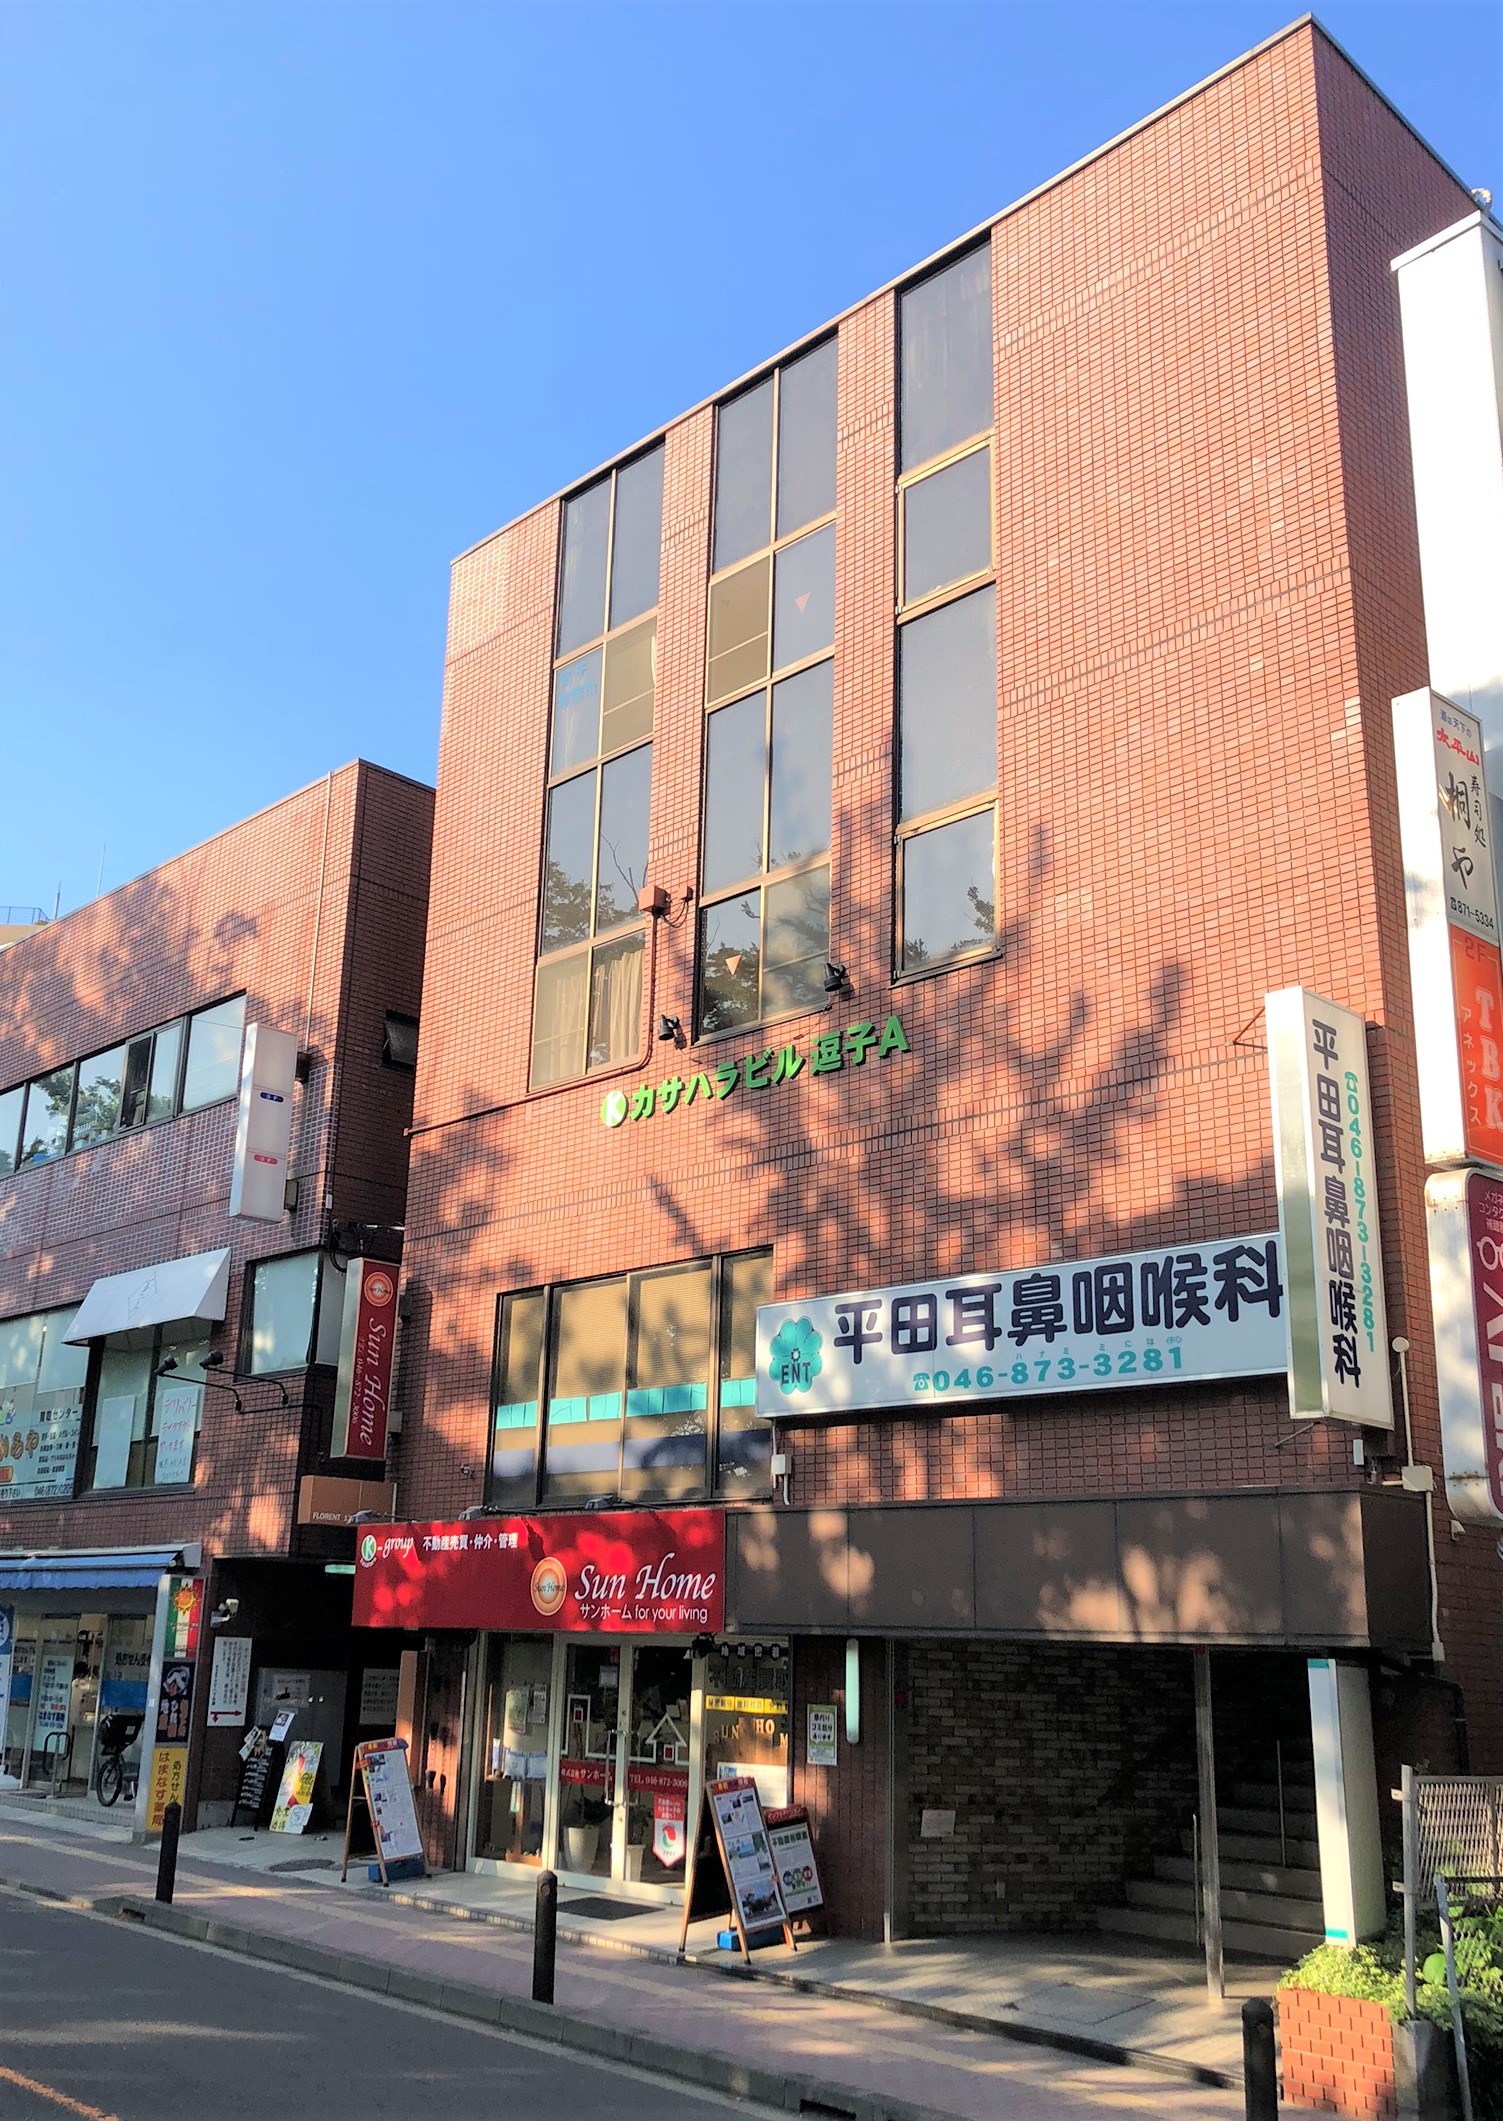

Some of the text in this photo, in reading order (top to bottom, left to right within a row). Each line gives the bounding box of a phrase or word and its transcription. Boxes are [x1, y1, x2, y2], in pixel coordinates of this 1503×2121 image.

[1437, 727, 1480, 766] 太平山
[1470, 773, 1487, 849] 寿司処
[1464, 936, 1487, 963] 2F
[1460, 1006, 1482, 1126] アネックス
[1475, 986, 1503, 1132] TBK
[1311, 1019, 1362, 1389] 平田耳鼻咽喉科
[1346, 1092, 1376, 1353] 046-873-3281
[833, 1240, 1284, 1365] 平田耳鼻咽喉科
[367, 1317, 387, 1367] Sun
[933, 1346, 1183, 1392] 046-873-3281
[782, 1361, 811, 1385] ENT
[360, 1373, 386, 1446] Home
[313, 1512, 341, 1521] FLORENT
[574, 1552, 717, 1601] Sun Home
[580, 1603, 708, 1624] サンホーム for your living
[151, 1751, 171, 1826] はまなす薬局
